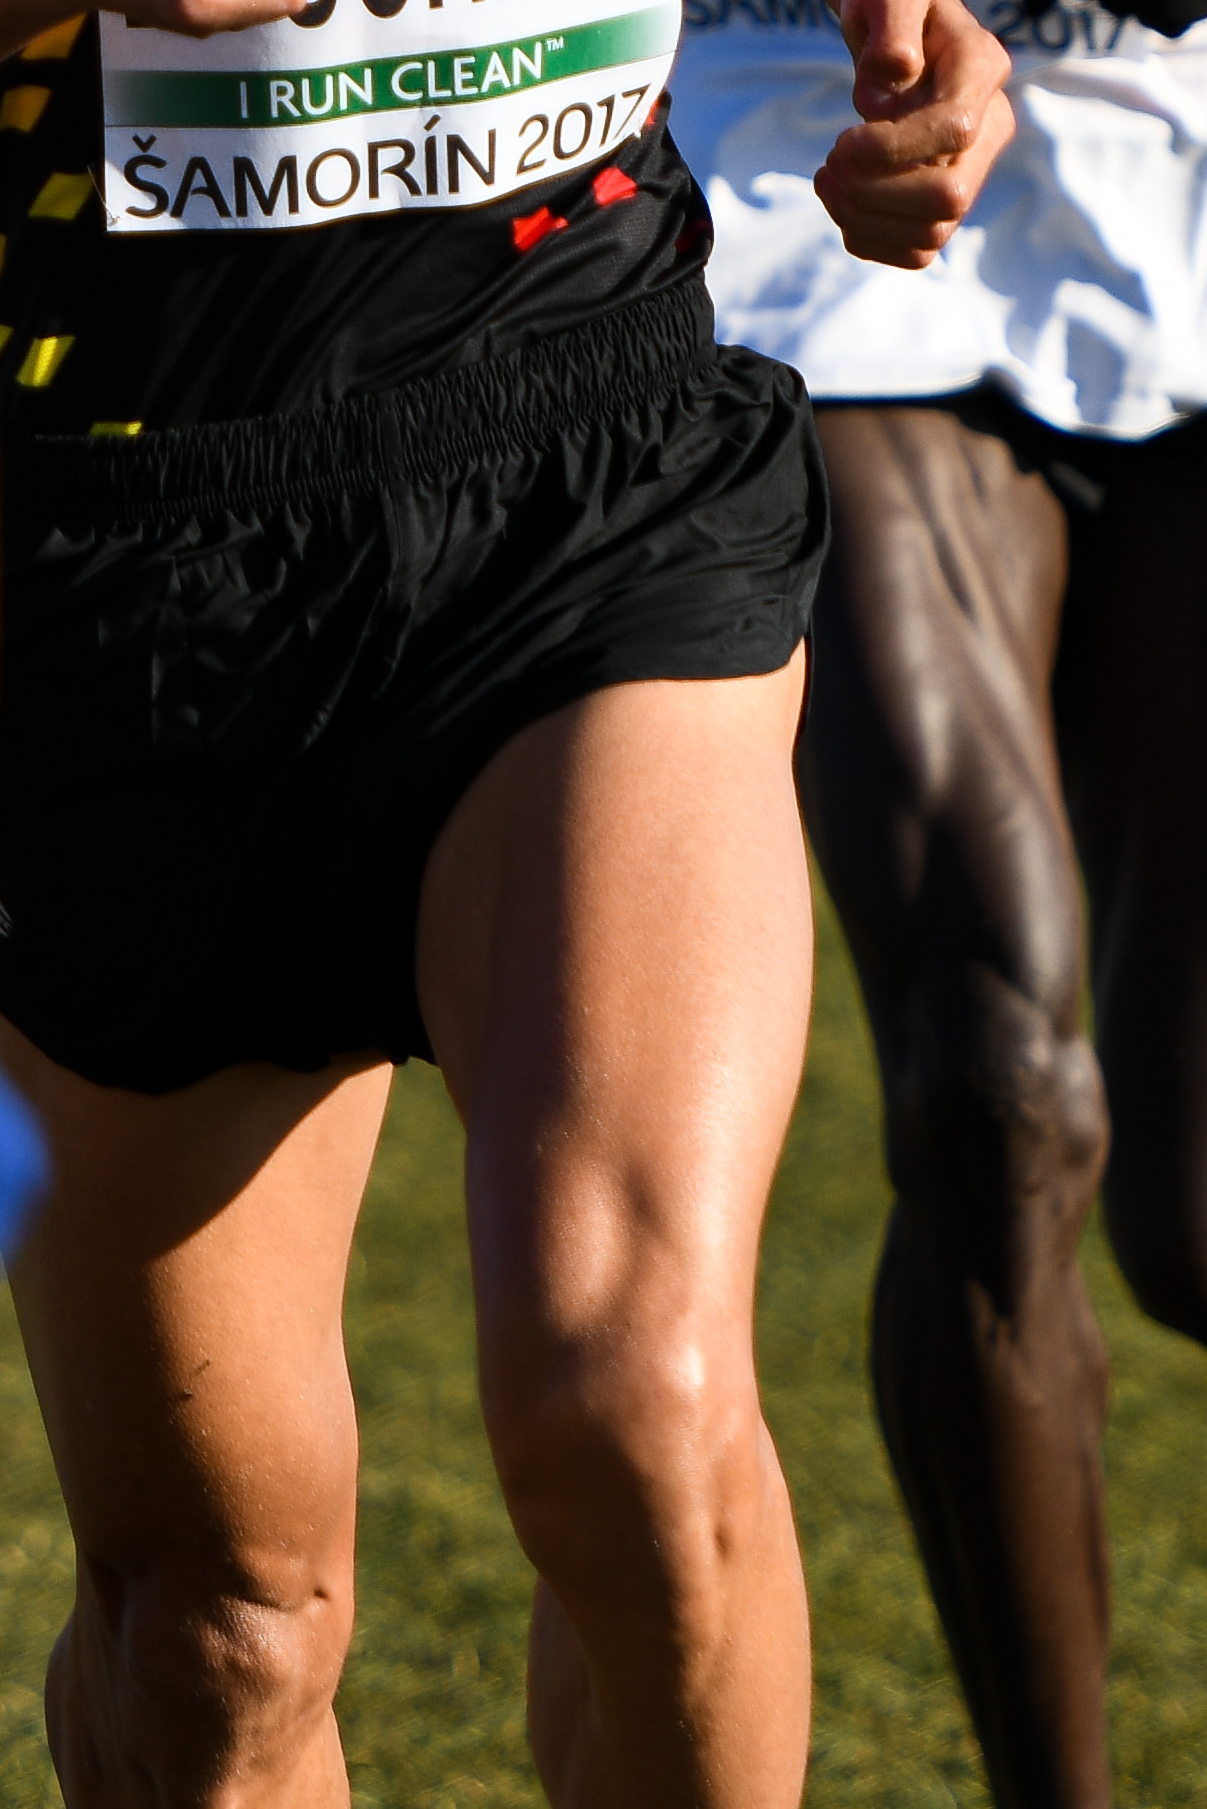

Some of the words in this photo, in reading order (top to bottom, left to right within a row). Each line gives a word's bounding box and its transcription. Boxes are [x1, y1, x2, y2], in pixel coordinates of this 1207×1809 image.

[239, 81, 249, 118] I
[270, 68, 373, 118] RUN
[124, 114, 497, 219] ŠAMORÍN
[517, 83, 651, 176] 2017
